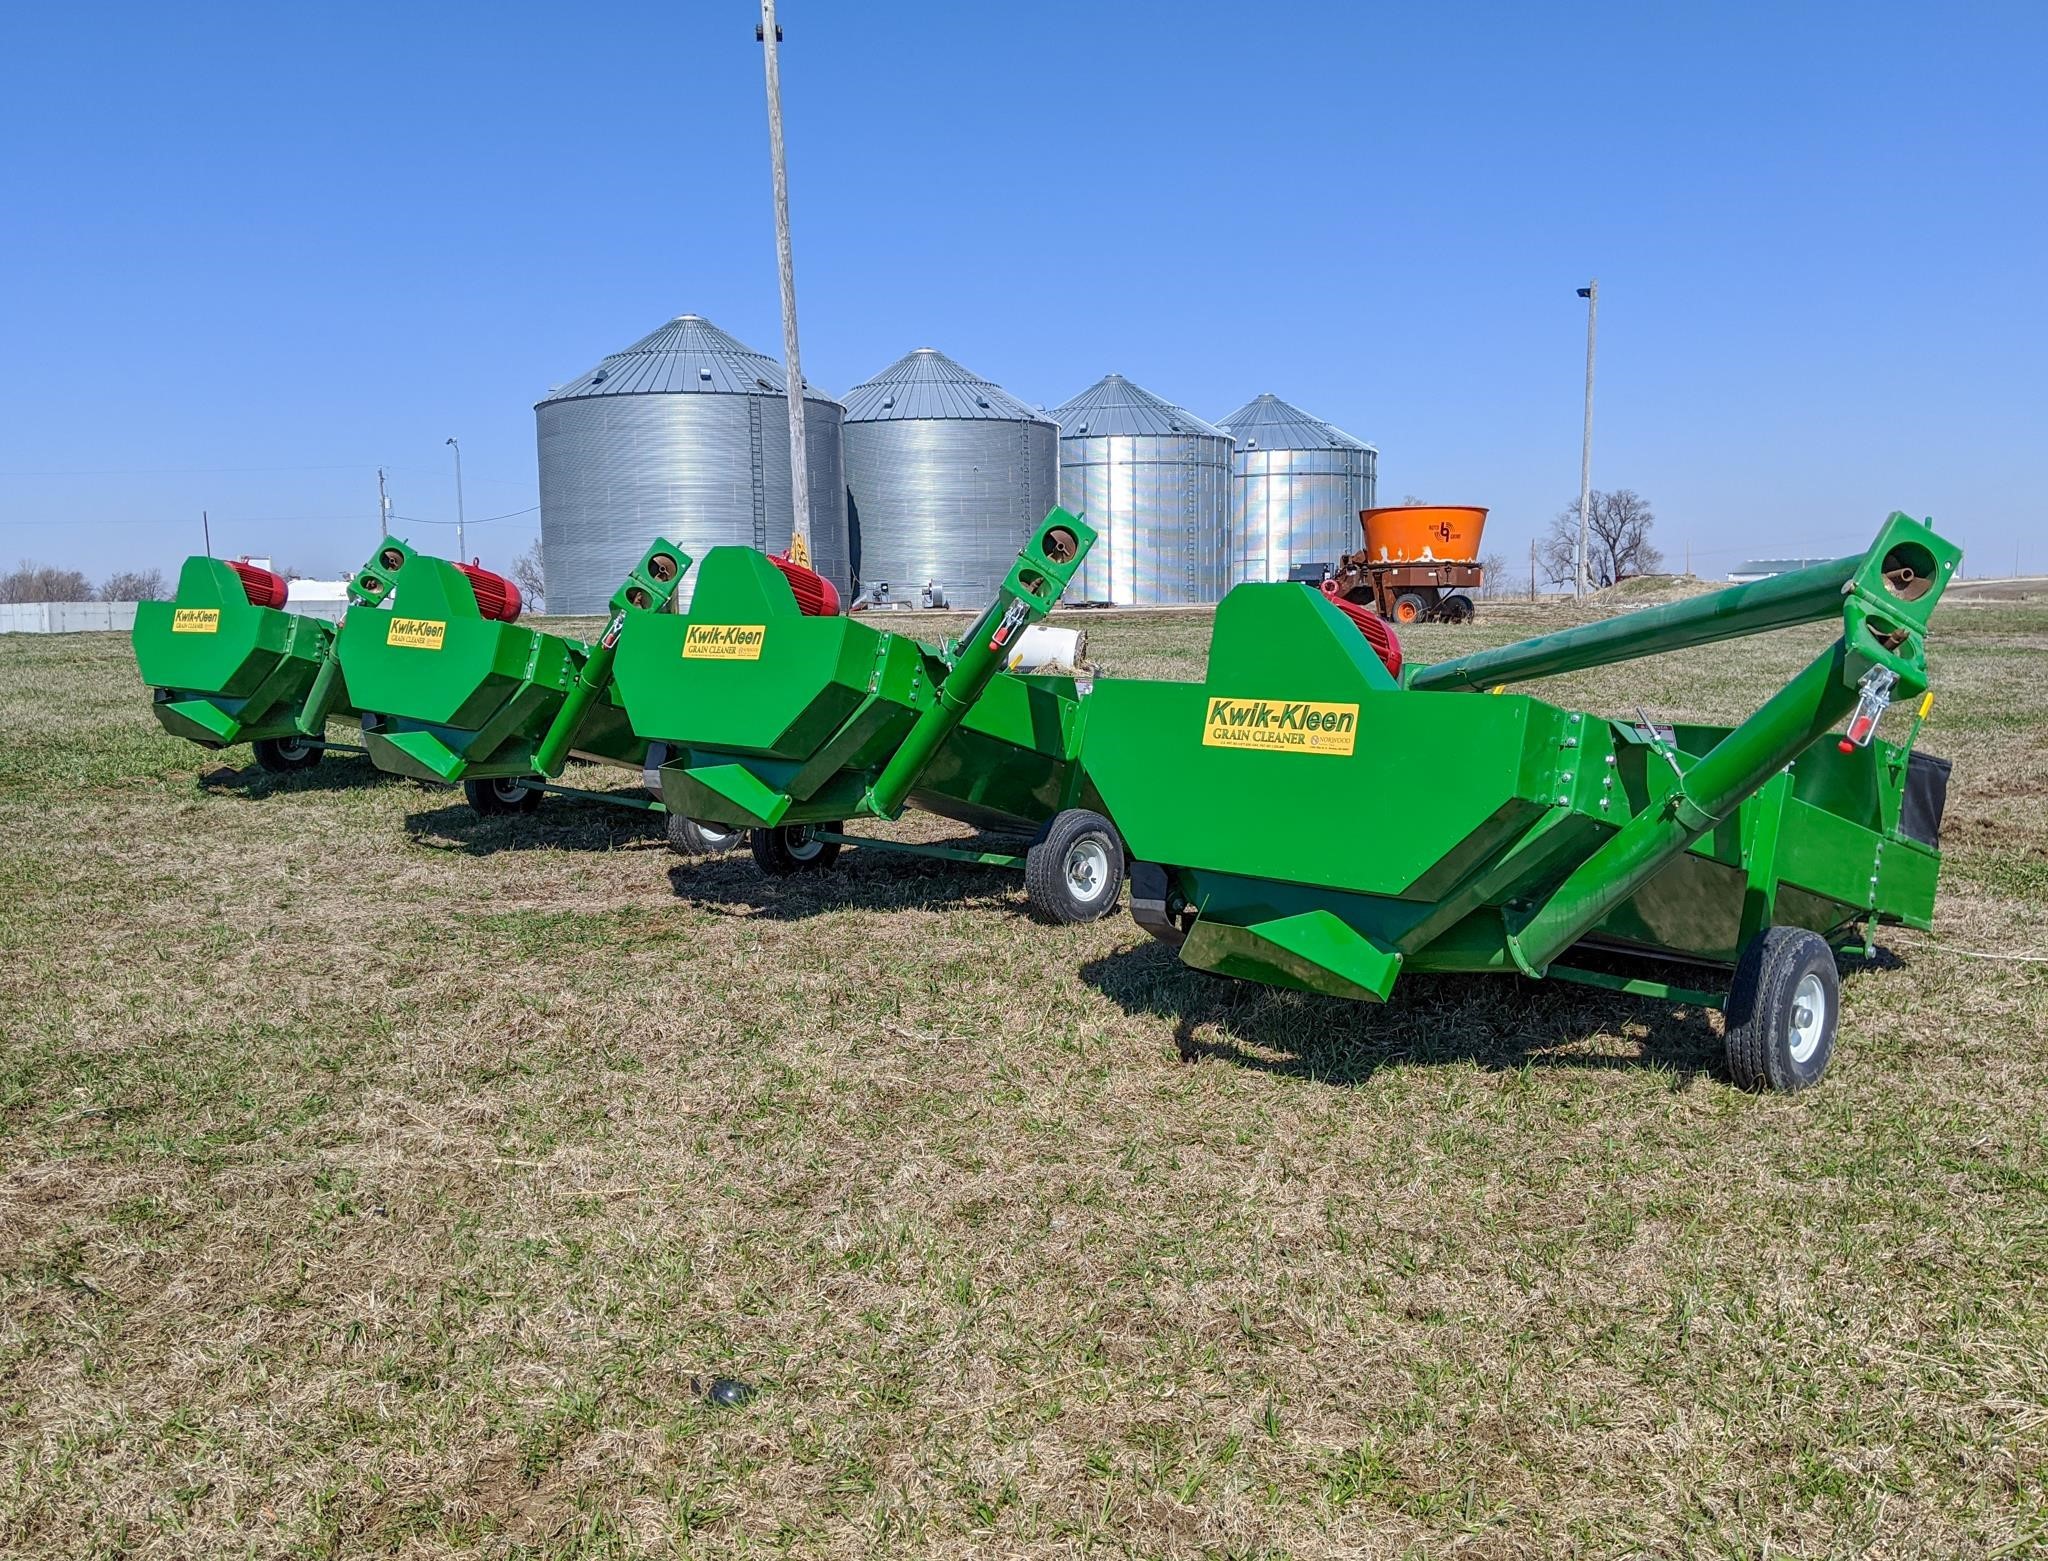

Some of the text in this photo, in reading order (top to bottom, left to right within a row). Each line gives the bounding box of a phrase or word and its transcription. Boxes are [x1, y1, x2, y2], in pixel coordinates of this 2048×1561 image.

[176, 610, 218, 622] Kwik-Kleen
[390, 619, 444, 637] Kwik-Kleen
[687, 626, 762, 645] Kwik-Kleen
[688, 645, 708, 654] GRAIN
[708, 646, 737, 654] CLEANER
[1208, 700, 1355, 733] Kwik-Kleen
[1212, 728, 1251, 742] GRAIN
[1252, 730, 1306, 745] CLEANER
